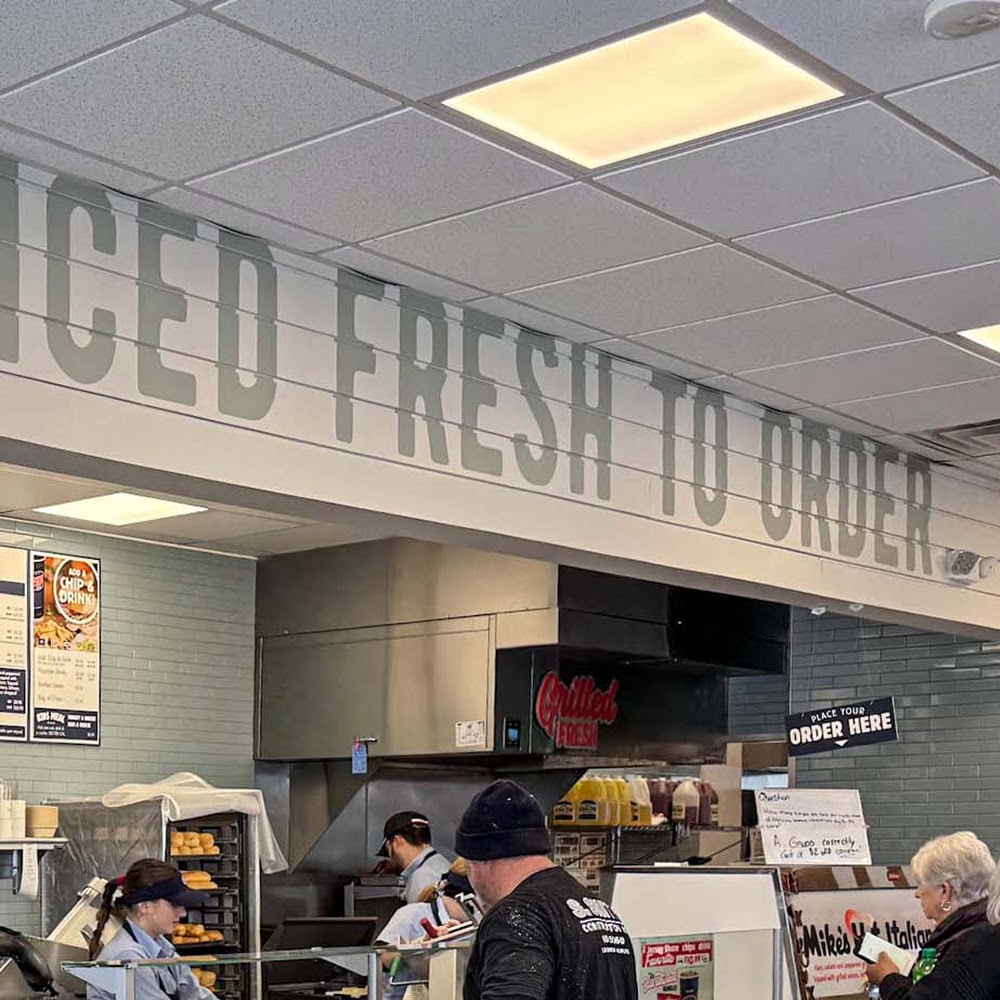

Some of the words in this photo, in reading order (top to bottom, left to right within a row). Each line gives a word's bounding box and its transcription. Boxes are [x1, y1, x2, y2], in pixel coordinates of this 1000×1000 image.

[334, 267, 612, 500] FRESH
[650, 369, 728, 527] TO
[759, 406, 933, 575] ORDER
[60, 577, 84, 590] CHIP
[87, 580, 94, 592] &
[790, 721, 843, 745] ORDER
[849, 712, 892, 735] HERE
[811, 709, 837, 723] PLACE
[840, 707, 865, 716] YOUR
[803, 924, 850, 956] Mike's
[851, 921, 880, 955] Ht
